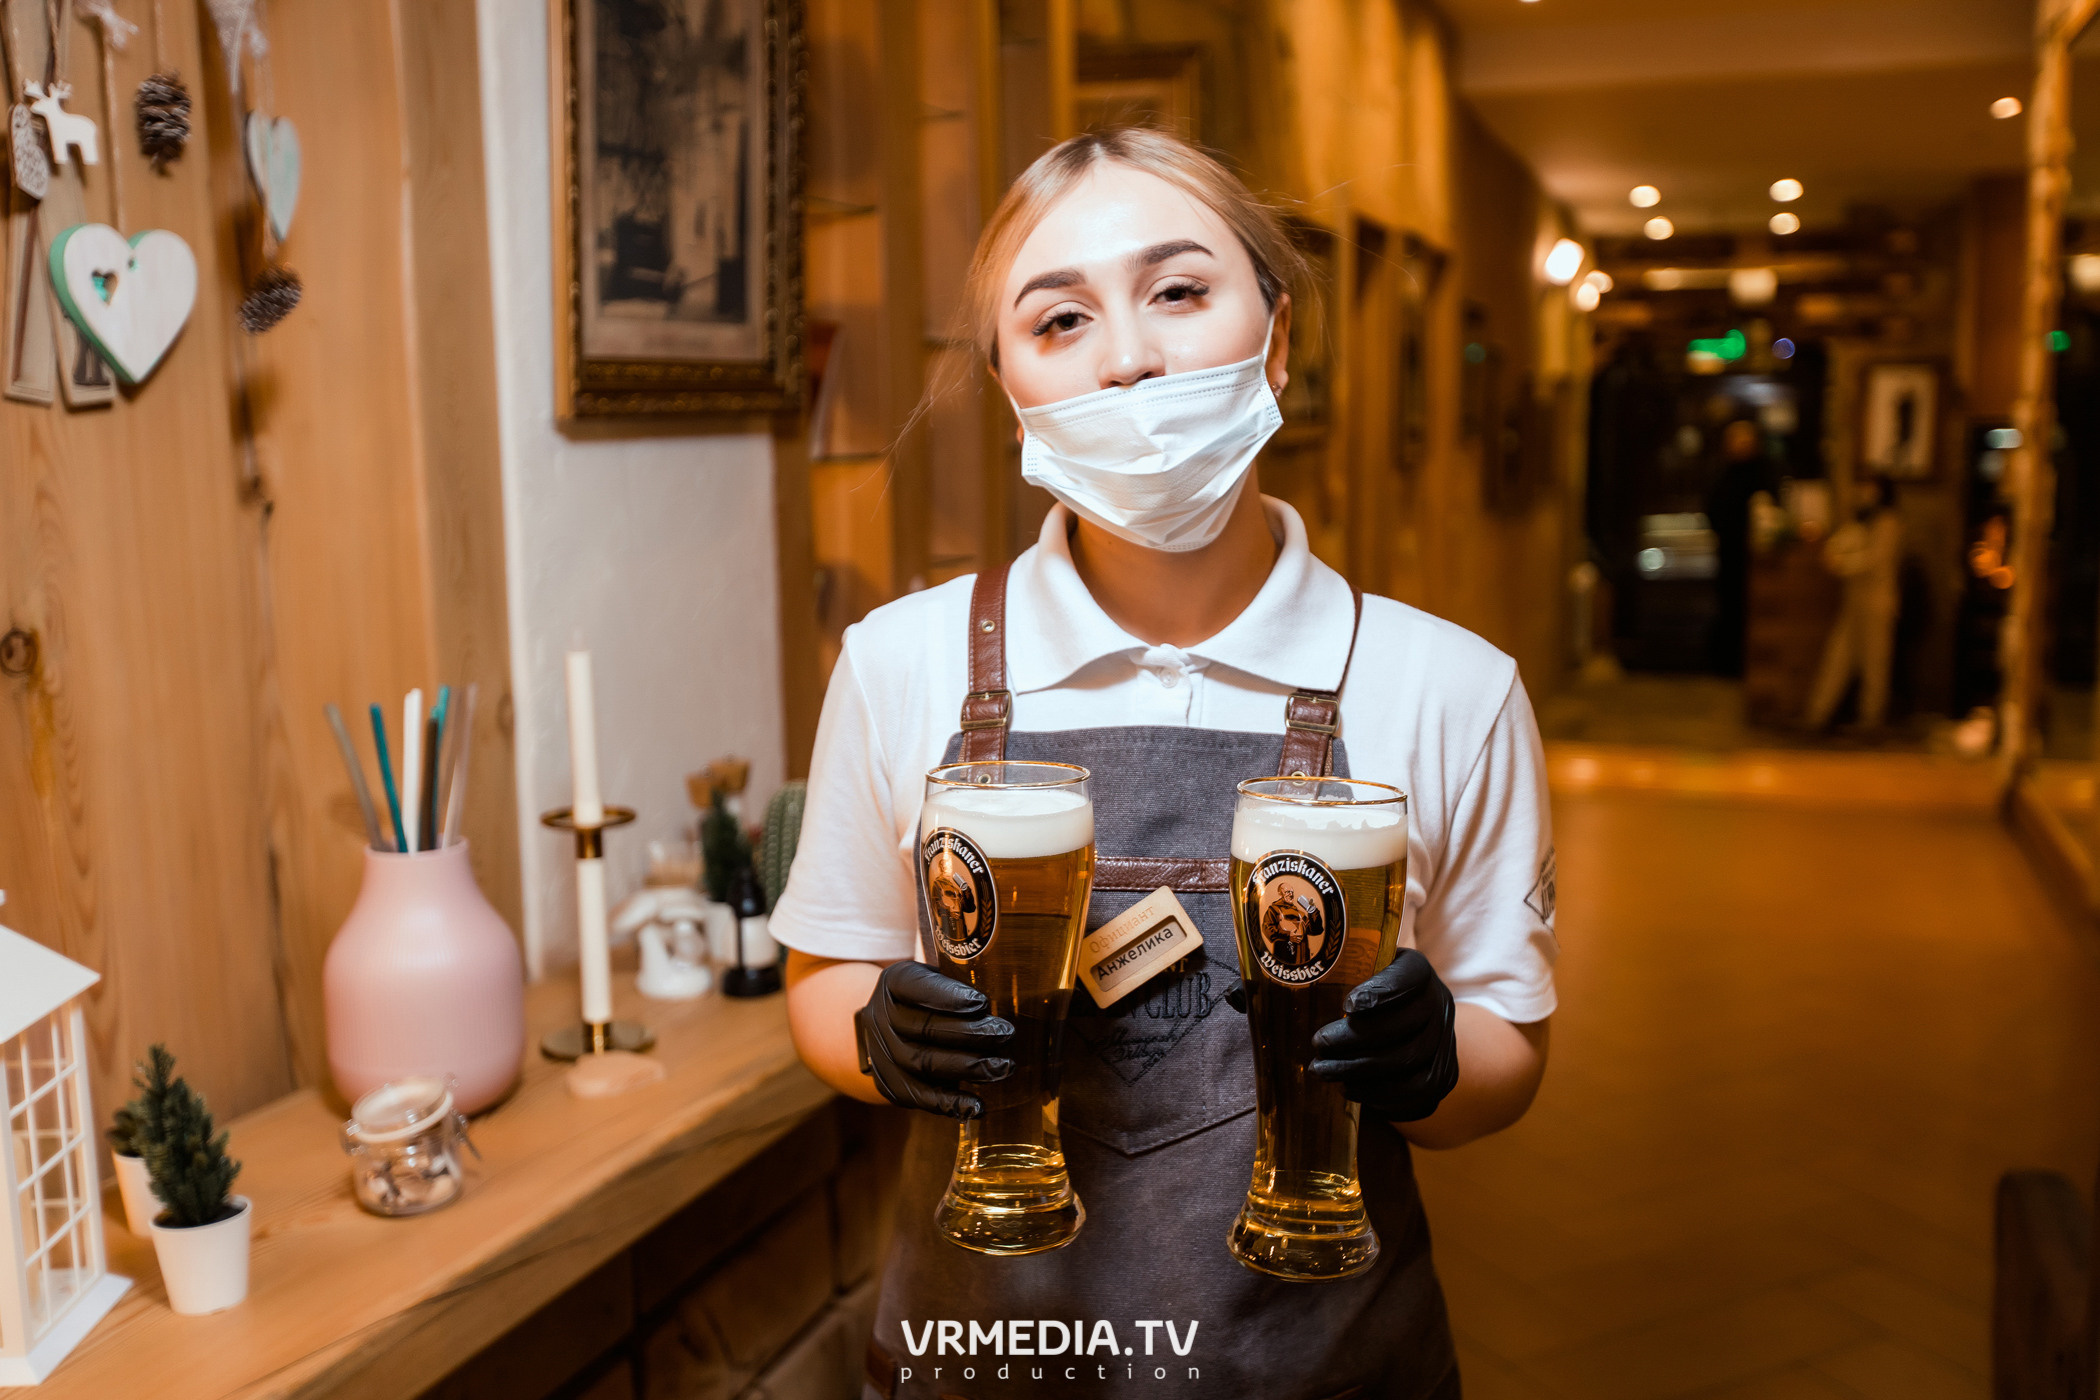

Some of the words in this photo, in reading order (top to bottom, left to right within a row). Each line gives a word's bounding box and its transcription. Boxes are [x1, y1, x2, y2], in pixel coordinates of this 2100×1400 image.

[1252, 857, 1334, 898] Franziskaner
[1089, 906, 1154, 953] Официант
[1097, 927, 1174, 980] Анжелика
[1260, 951, 1325, 982] Weissbier
[1145, 972, 1212, 1019] CLUB
